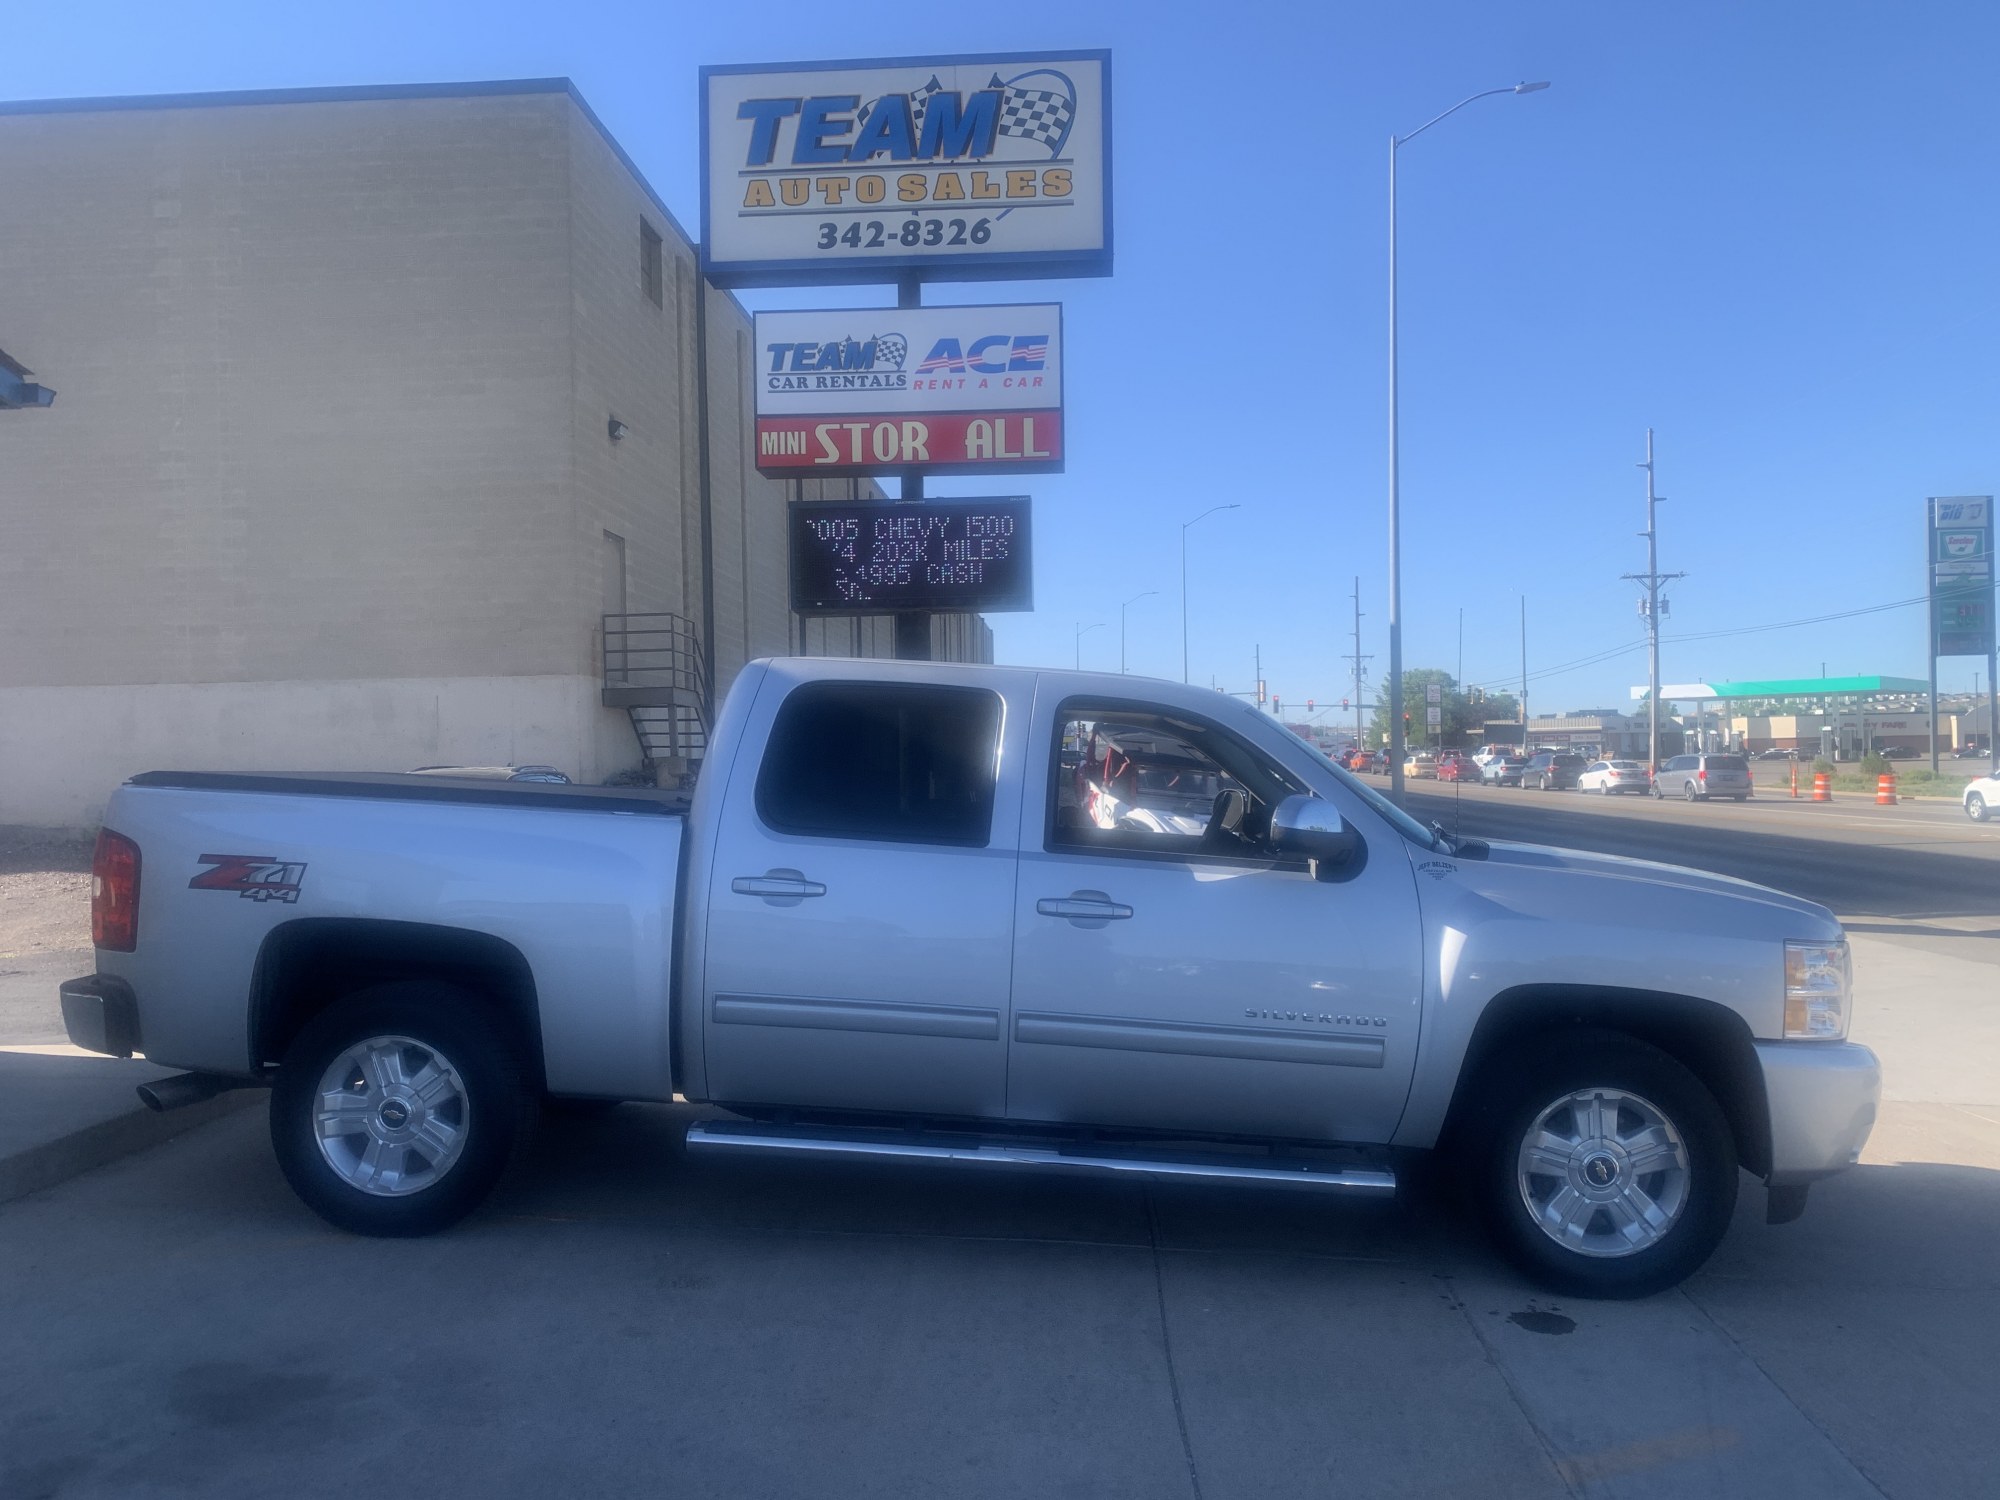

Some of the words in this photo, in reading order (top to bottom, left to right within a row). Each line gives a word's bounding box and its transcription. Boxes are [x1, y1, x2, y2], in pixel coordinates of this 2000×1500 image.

[736, 88, 1005, 168] TEAM
[743, 174, 887, 208] AUTO
[896, 168, 1074, 202] SALES
[816, 217, 993, 250] 342-8326
[767, 340, 879, 373] TEAM
[914, 334, 1050, 375] ACE
[768, 375, 808, 390] CAR
[815, 373, 908, 389] RENTALS
[912, 378, 967, 391] RENT
[978, 378, 989, 389] A
[1003, 376, 1045, 388] CAR
[761, 431, 807, 456] MINI
[814, 420, 930, 464] STOR
[965, 416, 1050, 460] ALL
[806, 518, 859, 541] 005
[875, 516, 950, 539] CHEVY
[966, 515, 1014, 537] 1500
[872, 540, 928, 562] 202K
[943, 538, 1009, 561] MILES
[927, 562, 984, 585] CASH
[188, 853, 309, 891] Z71
[1244, 1007, 1388, 1027] SILVERADO
